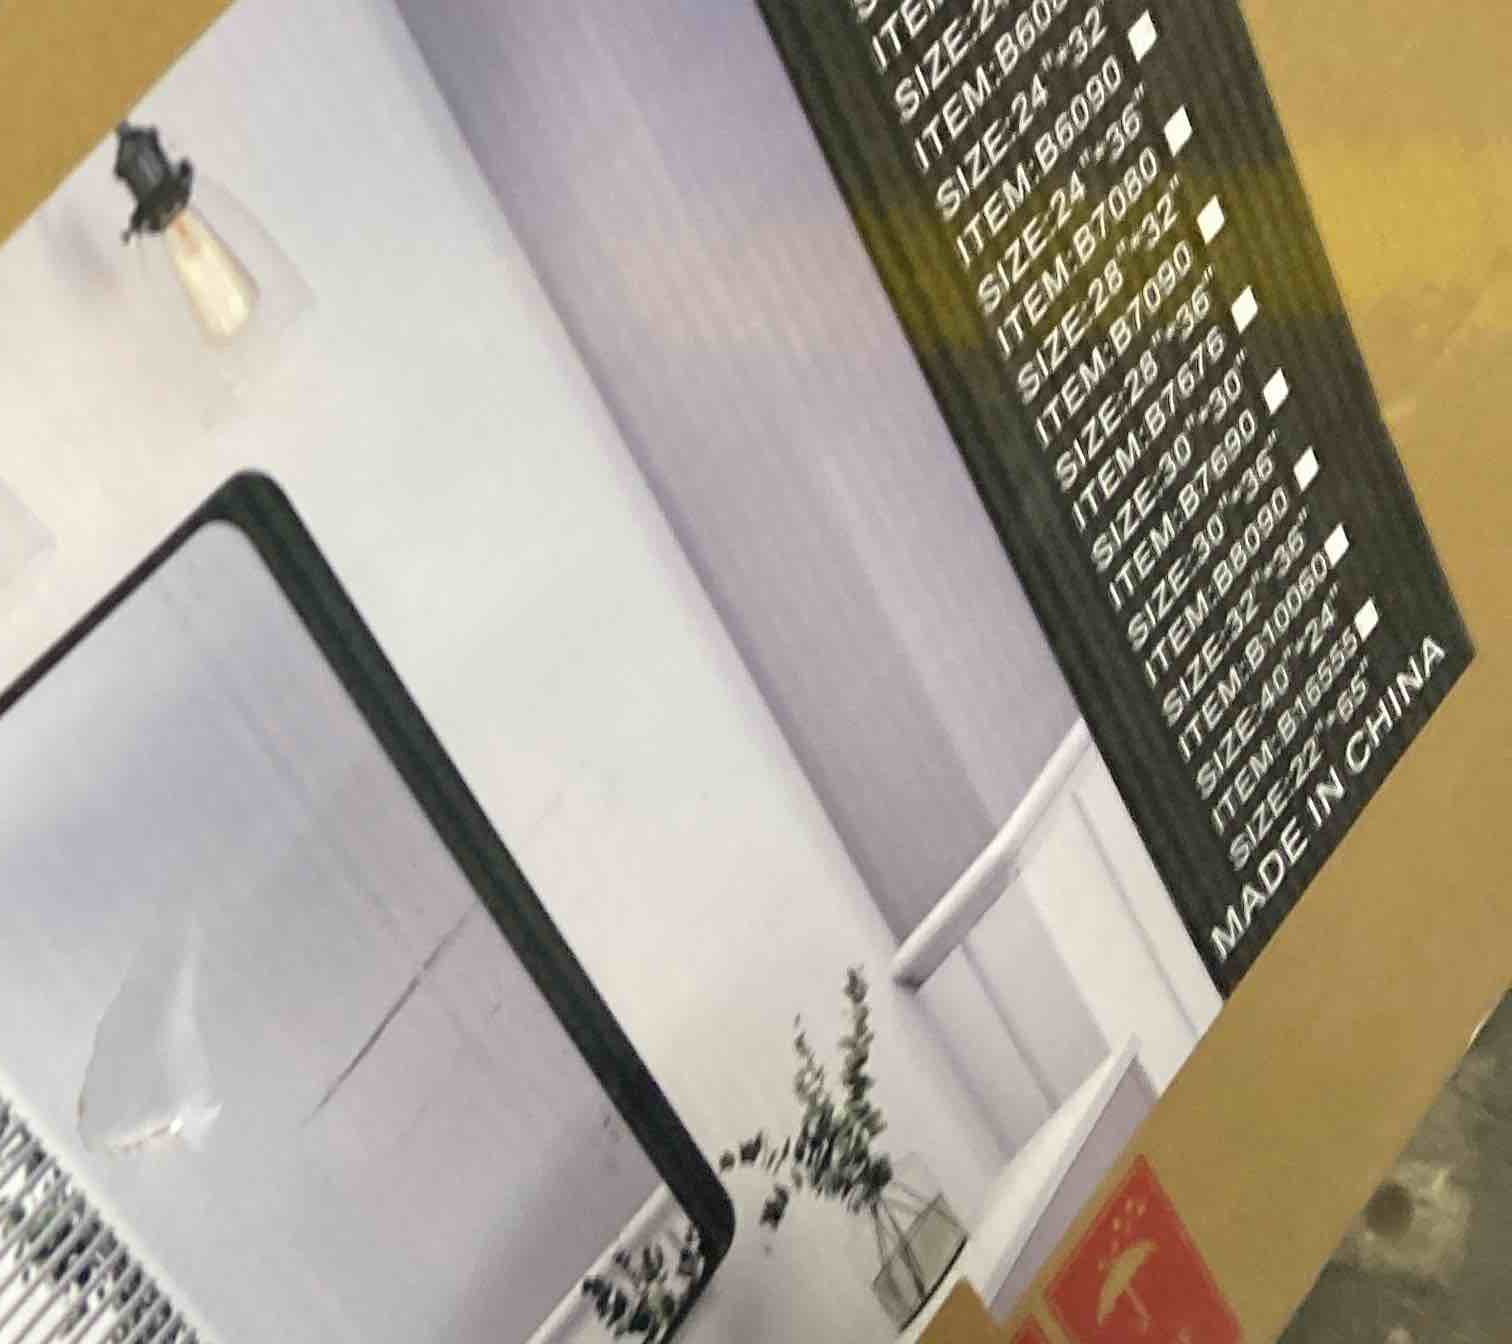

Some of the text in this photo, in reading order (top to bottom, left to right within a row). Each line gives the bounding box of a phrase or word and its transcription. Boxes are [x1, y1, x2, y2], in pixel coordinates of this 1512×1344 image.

[955, 54, 1121, 268] ITEM:B6090
[996, 146, 1157, 359] ITEM:B7080
[1035, 239, 1192, 448] ITEM:B7090
[1072, 325, 1224, 532] ITEM:B7676
[1108, 407, 1256, 611] ITEM:B7690
[1144, 485, 1288, 688] ITEM:B8090
[1210, 635, 1445, 962] MADE IN CHINA
